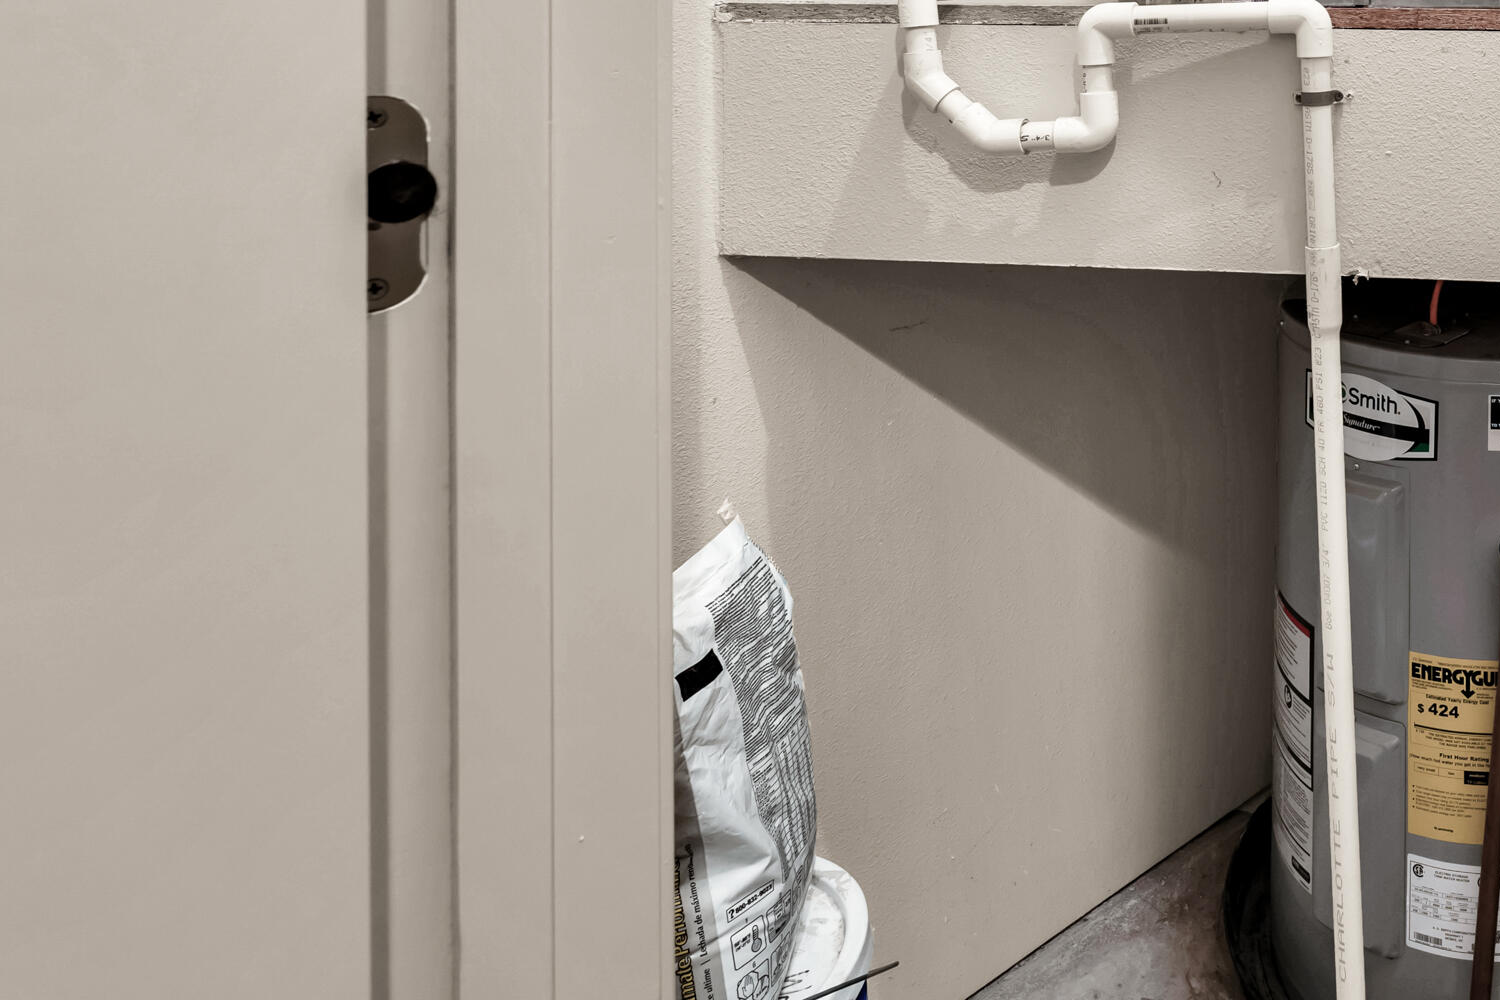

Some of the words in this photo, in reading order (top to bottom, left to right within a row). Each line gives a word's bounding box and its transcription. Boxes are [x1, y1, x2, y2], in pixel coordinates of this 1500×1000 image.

[1417, 704, 1424, 713] $
[1428, 703, 1459, 718] 424
[1330, 729, 1339, 799] PIPE
[689, 882, 700, 913] máximo
[1332, 819, 1346, 982] CHARLOTTE
[694, 914, 702, 925] de
[702, 969, 713, 992] ultime
